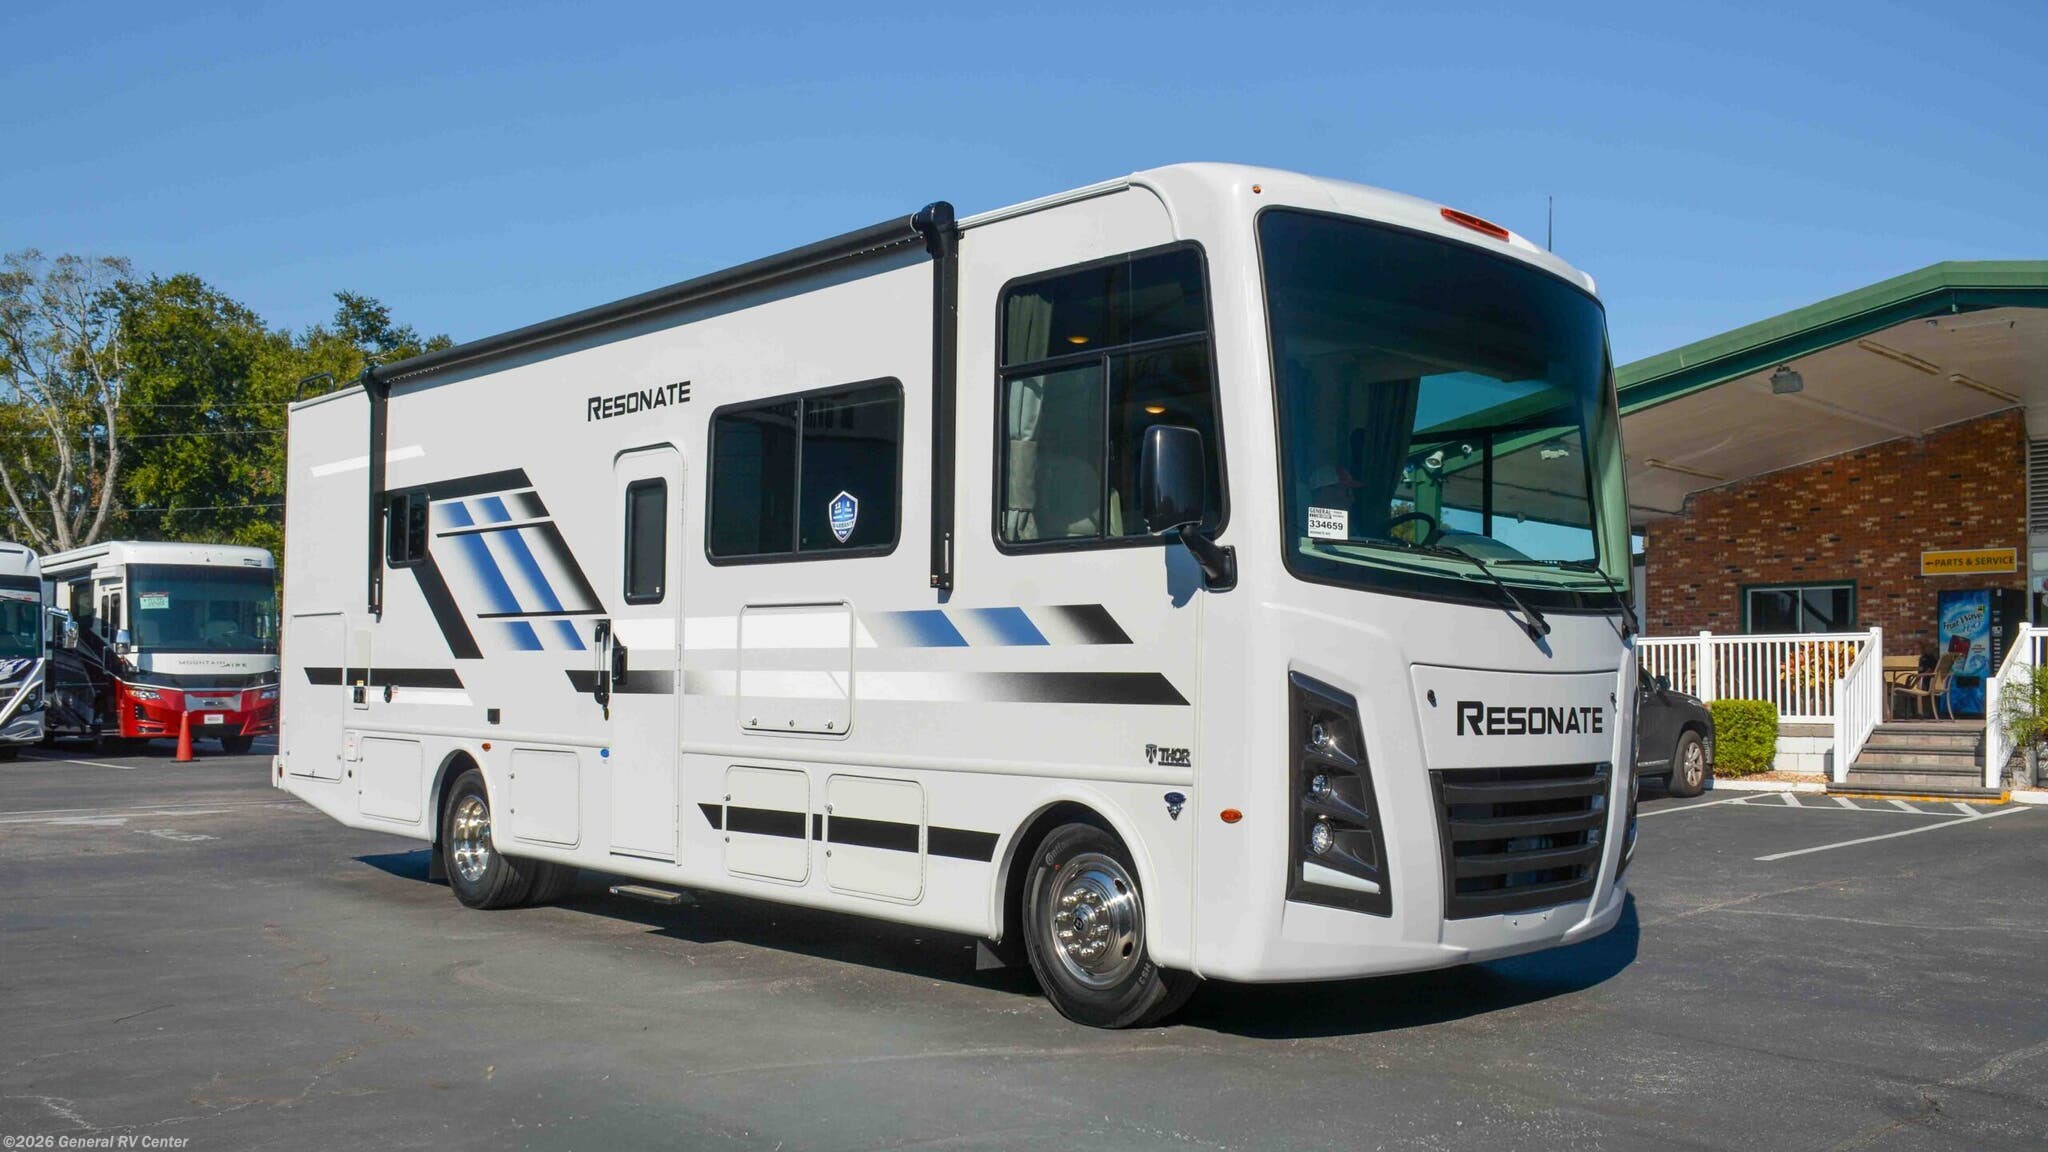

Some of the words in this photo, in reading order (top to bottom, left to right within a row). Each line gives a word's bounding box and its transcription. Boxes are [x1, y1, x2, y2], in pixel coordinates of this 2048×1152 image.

[587, 380, 691, 422] RESONATE
[1309, 520, 1344, 530] 334659
[1935, 558, 1963, 567] PARTS
[1966, 558, 1973, 566] &
[1975, 556, 2015, 566] SERVICE
[1457, 700, 1603, 736] RESONATE
[1158, 747, 1191, 762] THOR
